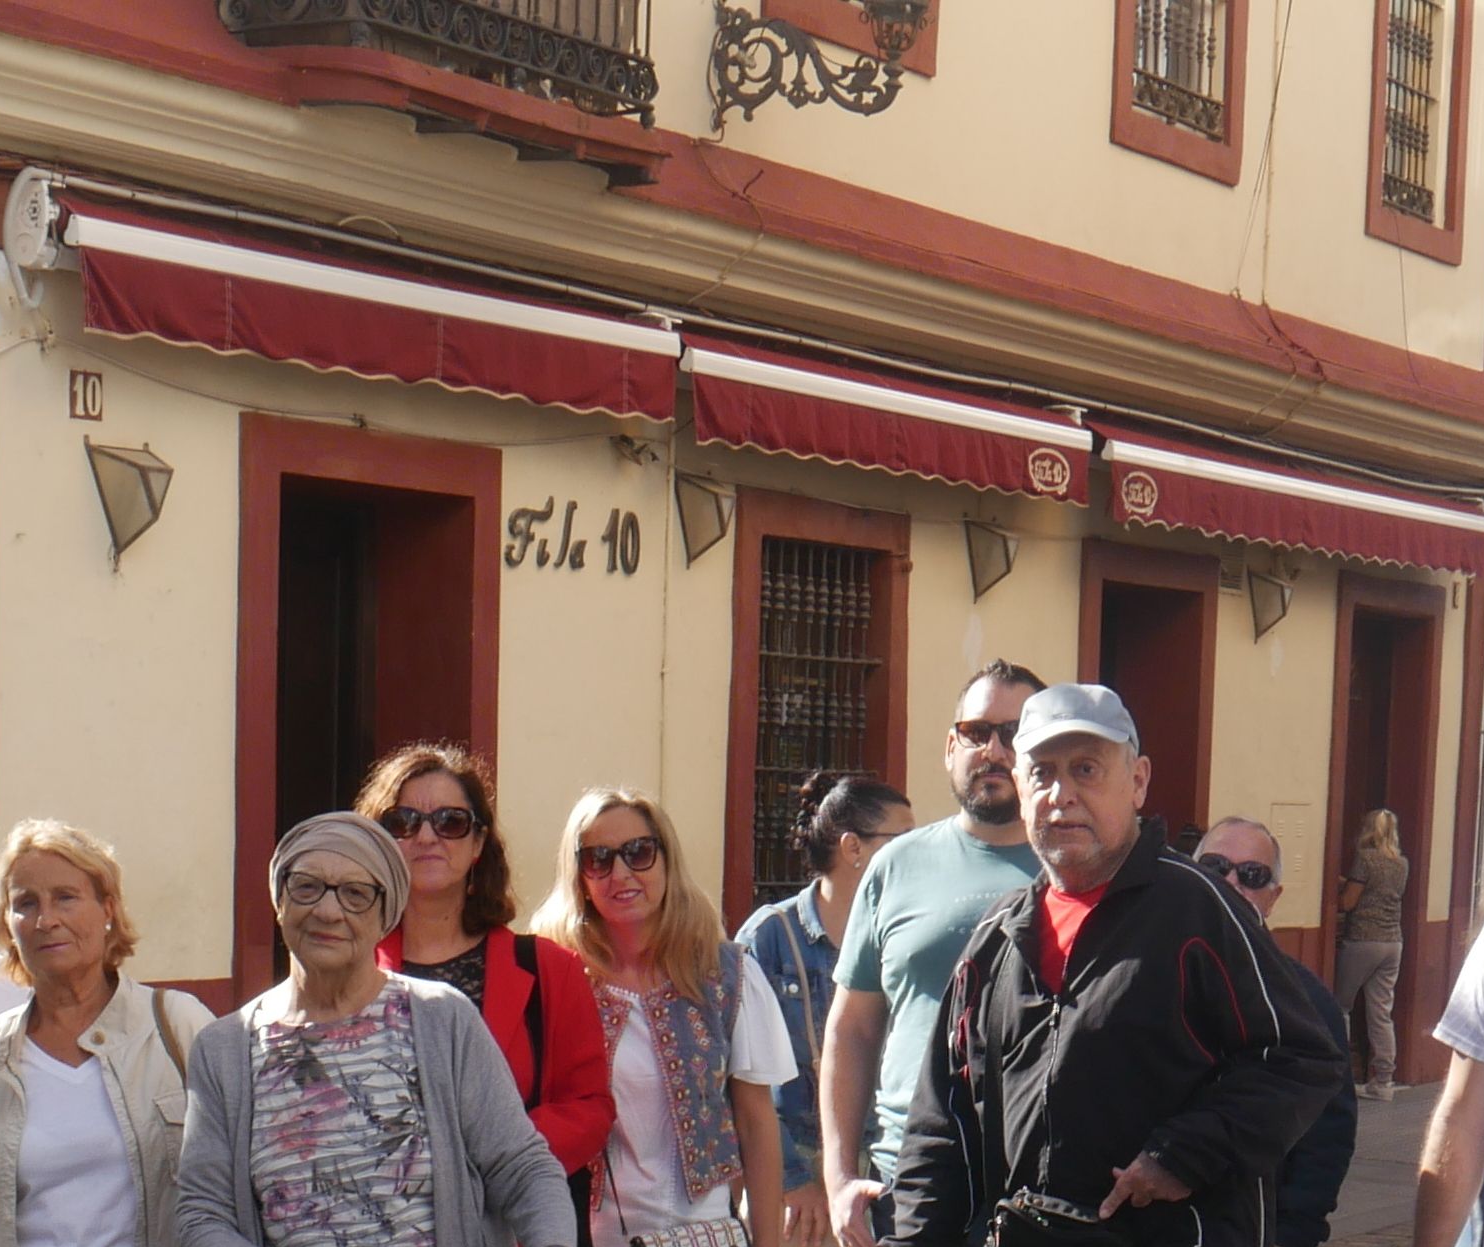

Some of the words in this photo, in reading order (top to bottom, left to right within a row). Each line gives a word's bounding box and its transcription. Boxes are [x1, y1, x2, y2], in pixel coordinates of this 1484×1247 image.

[73, 374, 102, 416] 10
[504, 496, 587, 568] Fila
[602, 508, 640, 575] 10
